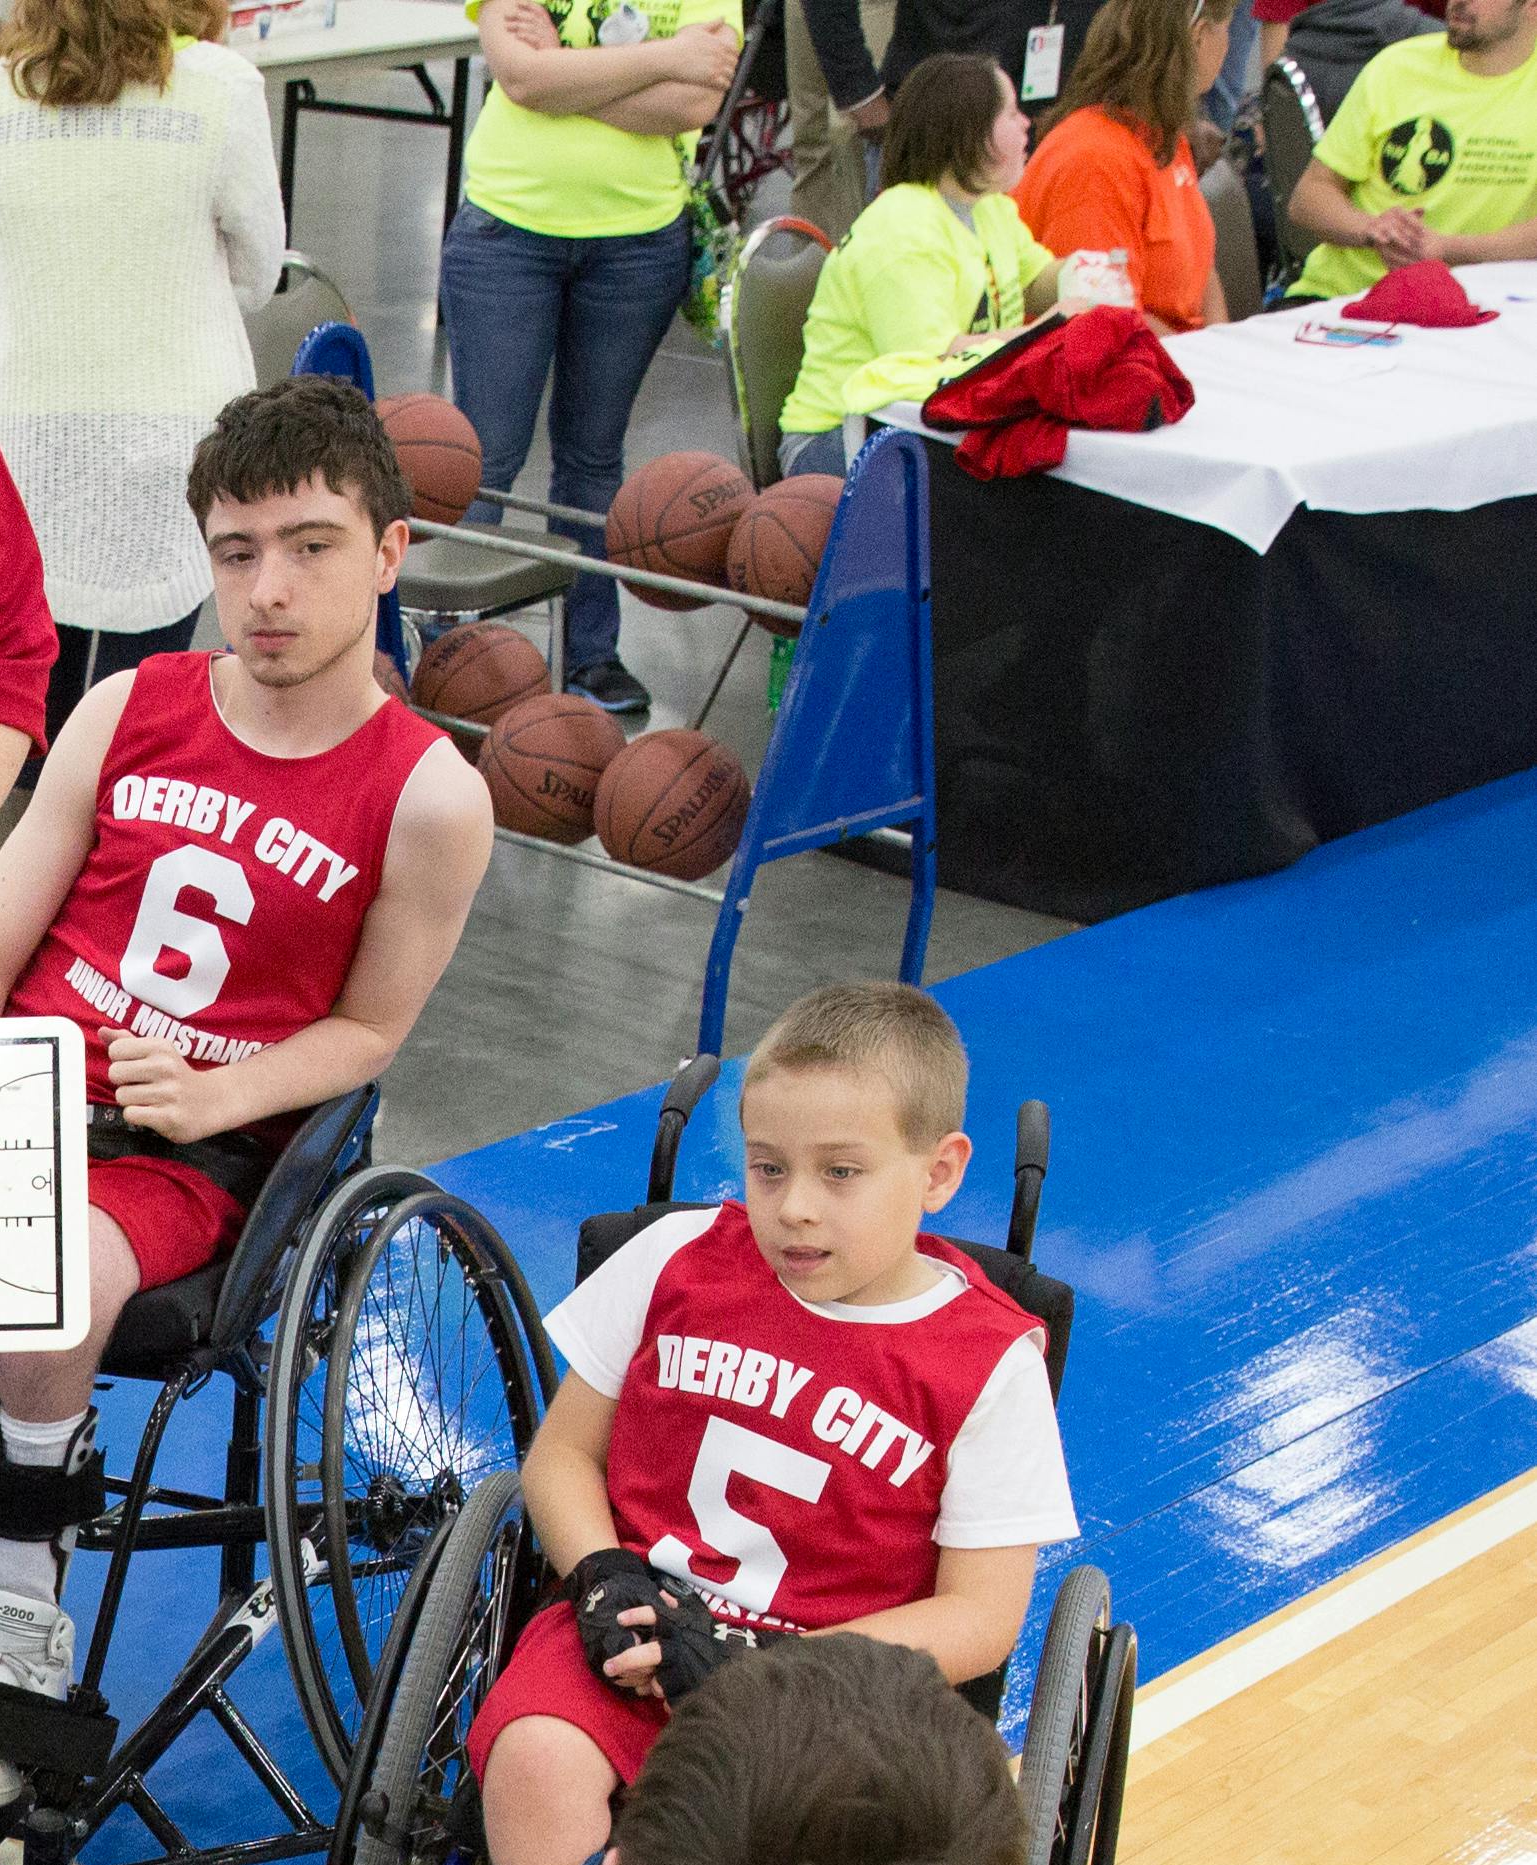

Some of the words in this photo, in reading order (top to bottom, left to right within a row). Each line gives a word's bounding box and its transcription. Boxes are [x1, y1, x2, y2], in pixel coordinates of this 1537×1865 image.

[112, 774, 258, 844] DERBY
[253, 816, 360, 904] CITY
[64, 955, 133, 1025] JUNIOR
[118, 842, 256, 1020] 6
[657, 1334, 816, 1420] DERBY
[810, 1384, 936, 1490] CITY
[647, 1414, 834, 1615] 5
